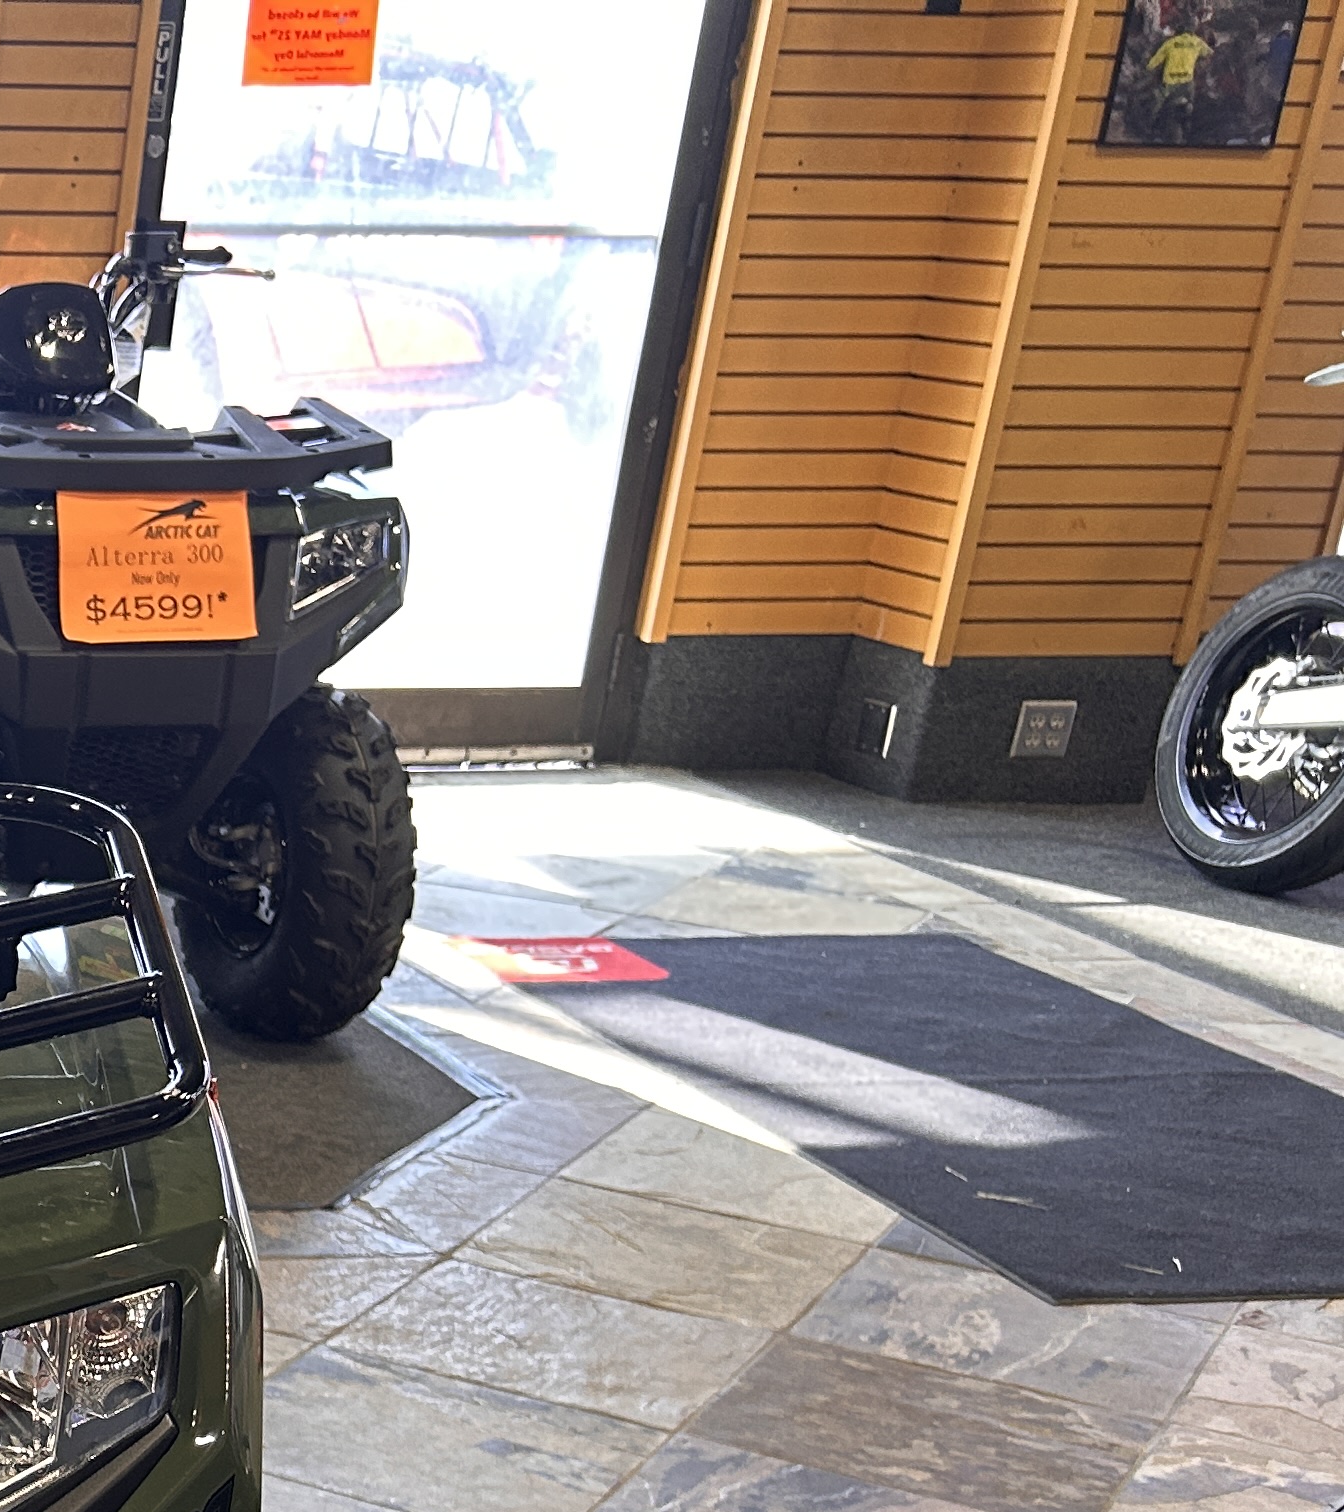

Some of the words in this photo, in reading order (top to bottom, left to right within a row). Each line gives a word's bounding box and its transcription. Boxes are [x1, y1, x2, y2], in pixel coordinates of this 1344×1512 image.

[153, 31, 170, 95] PULL
[144, 525, 193, 540] ARCTIC
[196, 524, 221, 539] CAT
[86, 545, 174, 567] Alterra
[187, 544, 224, 564] 300
[131, 572, 154, 586] Now
[156, 570, 181, 587] Only
